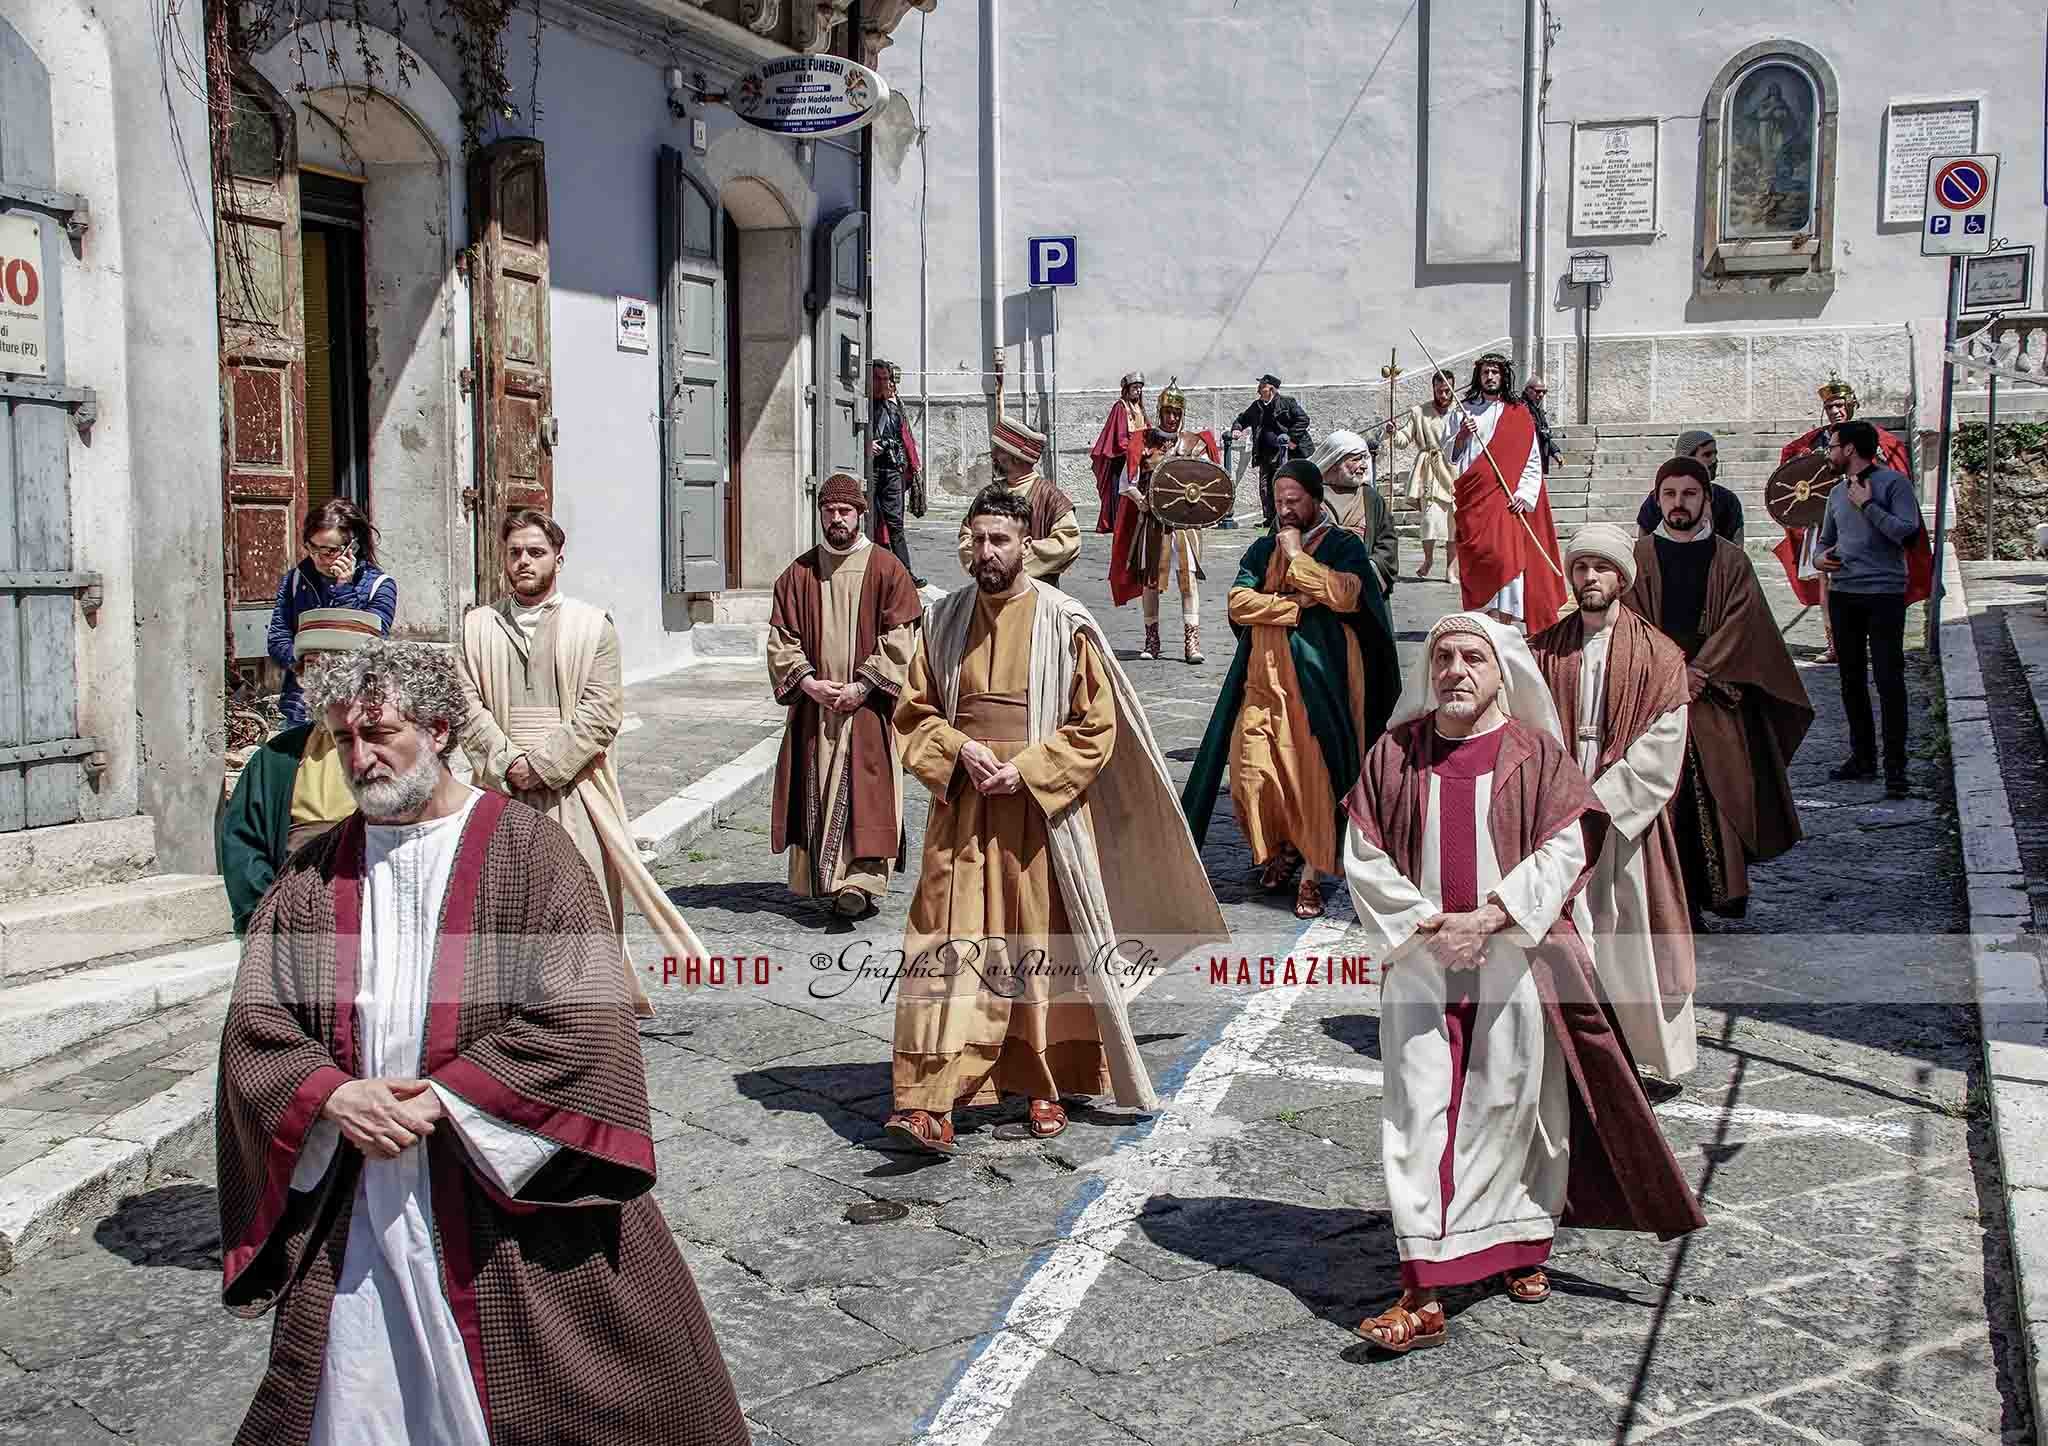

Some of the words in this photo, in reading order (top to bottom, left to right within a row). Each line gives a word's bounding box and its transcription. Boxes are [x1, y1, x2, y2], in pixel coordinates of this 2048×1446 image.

[808, 58, 844, 76] FUNEBRI
[807, 94, 843, 104] Maddalena
[807, 104, 832, 115] Nicola
[1935, 218, 1948, 232] P
[1040, 242, 1068, 282] P
[21, 341, 38, 357] (PZ)
